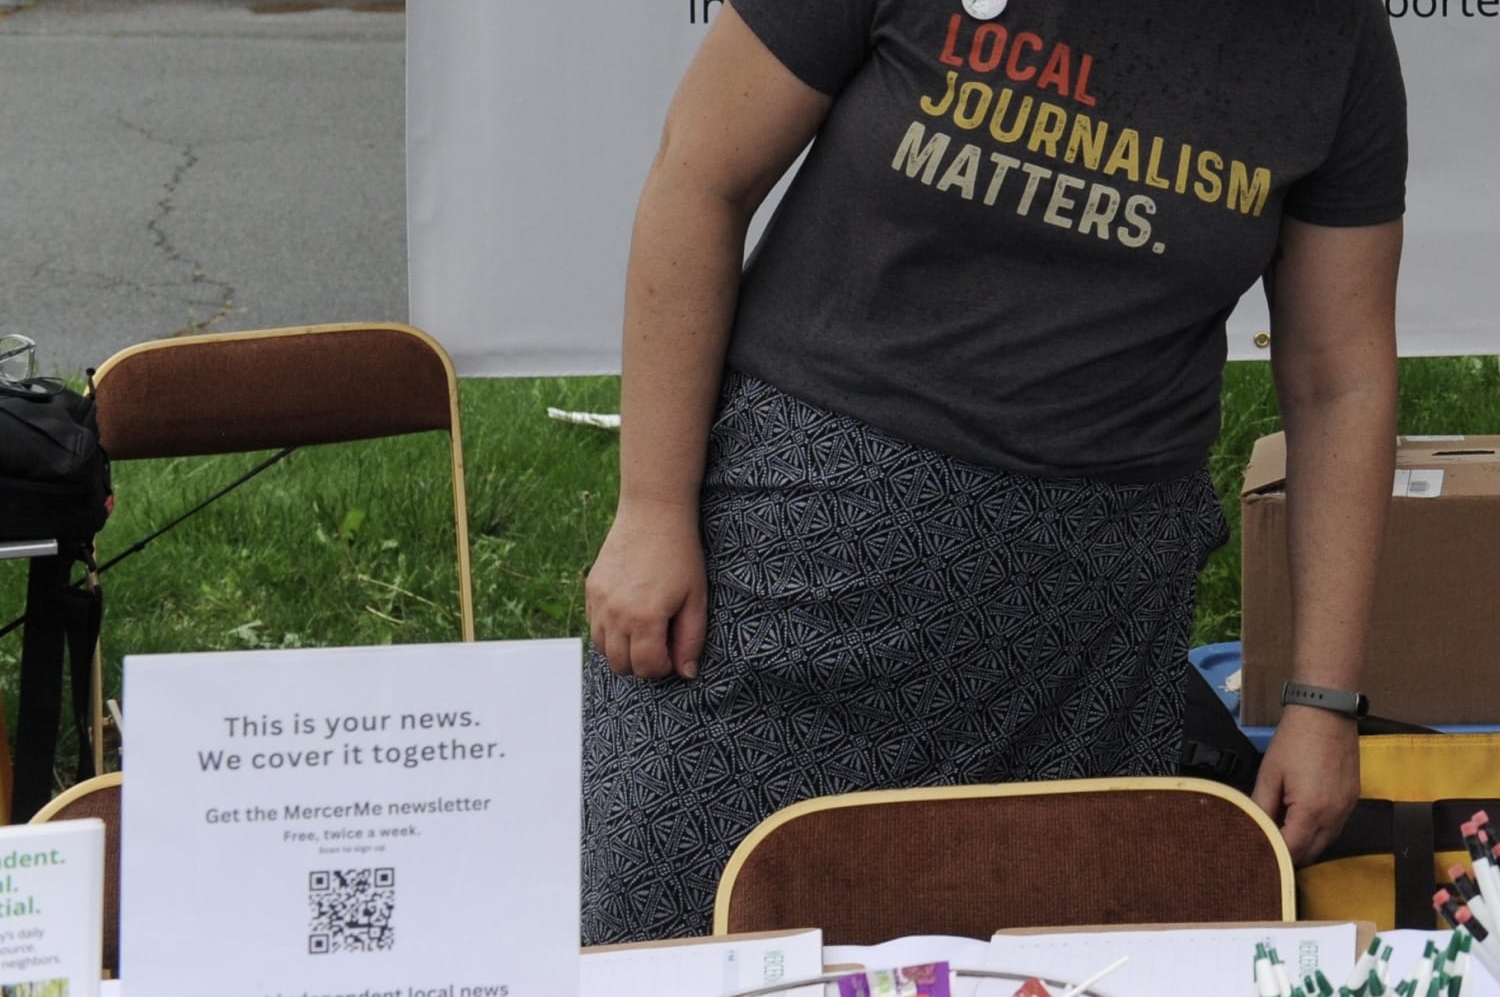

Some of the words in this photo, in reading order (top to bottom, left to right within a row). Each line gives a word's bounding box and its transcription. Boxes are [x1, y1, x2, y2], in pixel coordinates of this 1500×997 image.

[939, 13, 1097, 107] LOCAL
[920, 71, 1271, 217] JOURNALISM
[891, 121, 1166, 255] MATTERS.
[223, 714, 284, 737] This
[294, 713, 316, 735] is
[325, 714, 391, 740] your
[401, 711, 481, 730] news.
[198, 749, 242, 771] We
[251, 749, 334, 770] cover
[343, 743, 363, 765] it
[372, 738, 506, 769] together.
[205, 808, 241, 824] Get
[246, 805, 278, 822] the
[284, 801, 382, 820] MercerMe
[388, 796, 491, 816] newsletter
[283, 830, 320, 844] Free,
[324, 827, 363, 840] twice
[368, 829, 376, 838] a
[380, 824, 422, 838] week.
[460, 985, 509, 997] news
